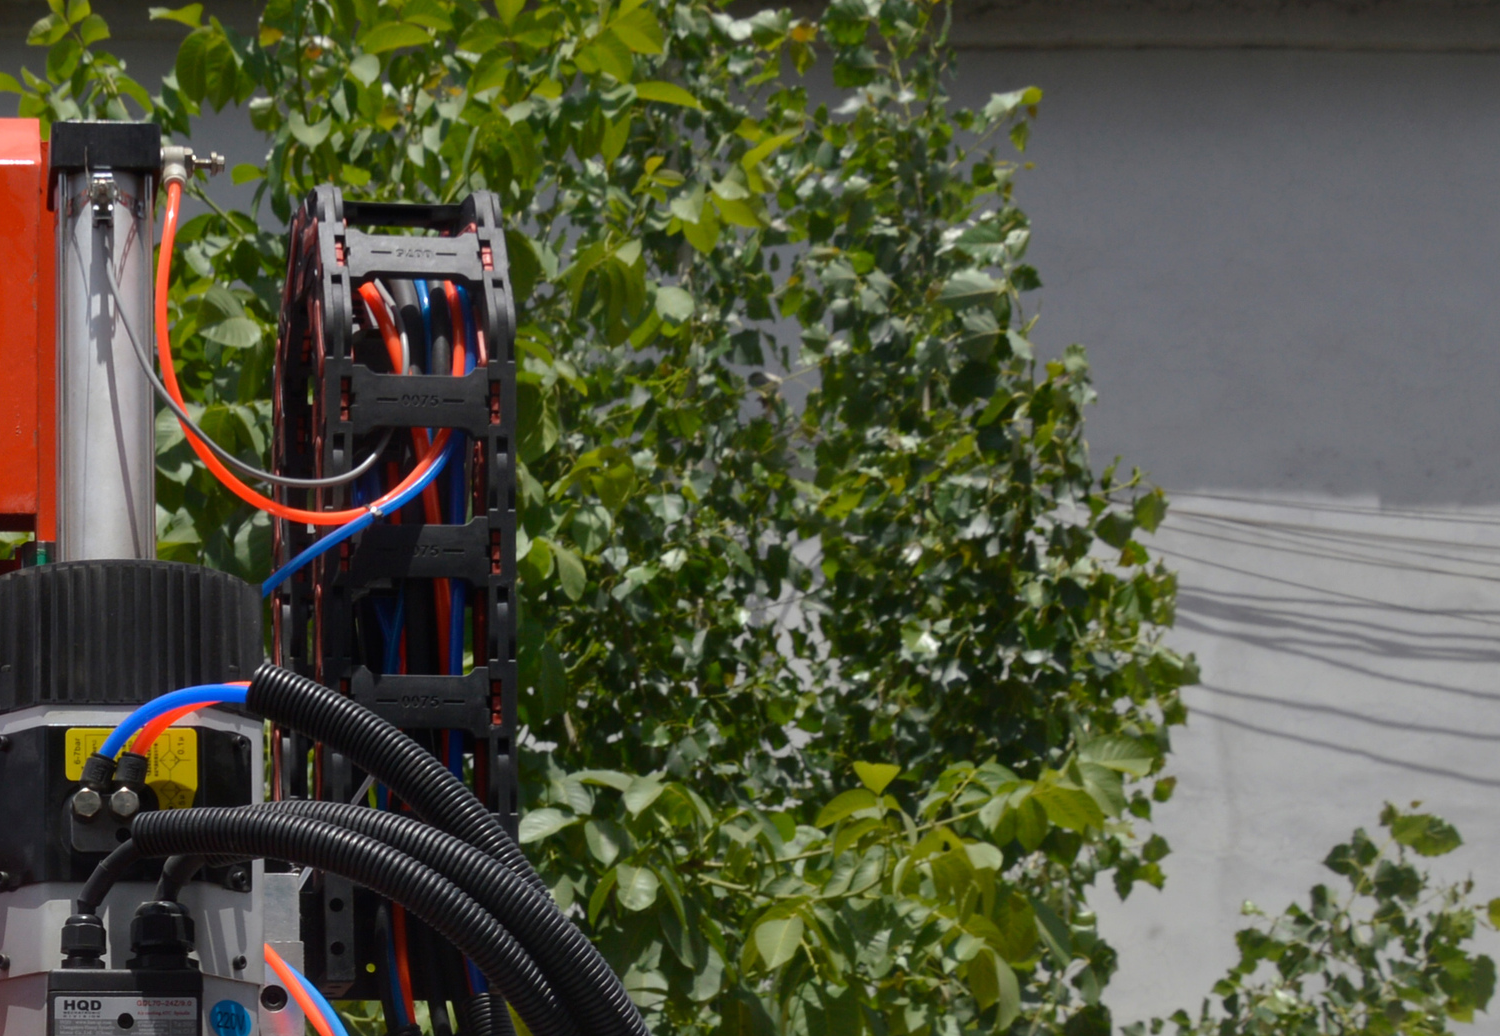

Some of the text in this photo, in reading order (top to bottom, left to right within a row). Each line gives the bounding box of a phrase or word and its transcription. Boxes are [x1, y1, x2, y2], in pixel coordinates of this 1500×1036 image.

[401, 394, 439, 408] 0075
[402, 695, 440, 708] 0075
[73, 737, 81, 765] 6-7bar
[63, 1000, 102, 1011] HQD
[216, 1011, 245, 1031] 220V
